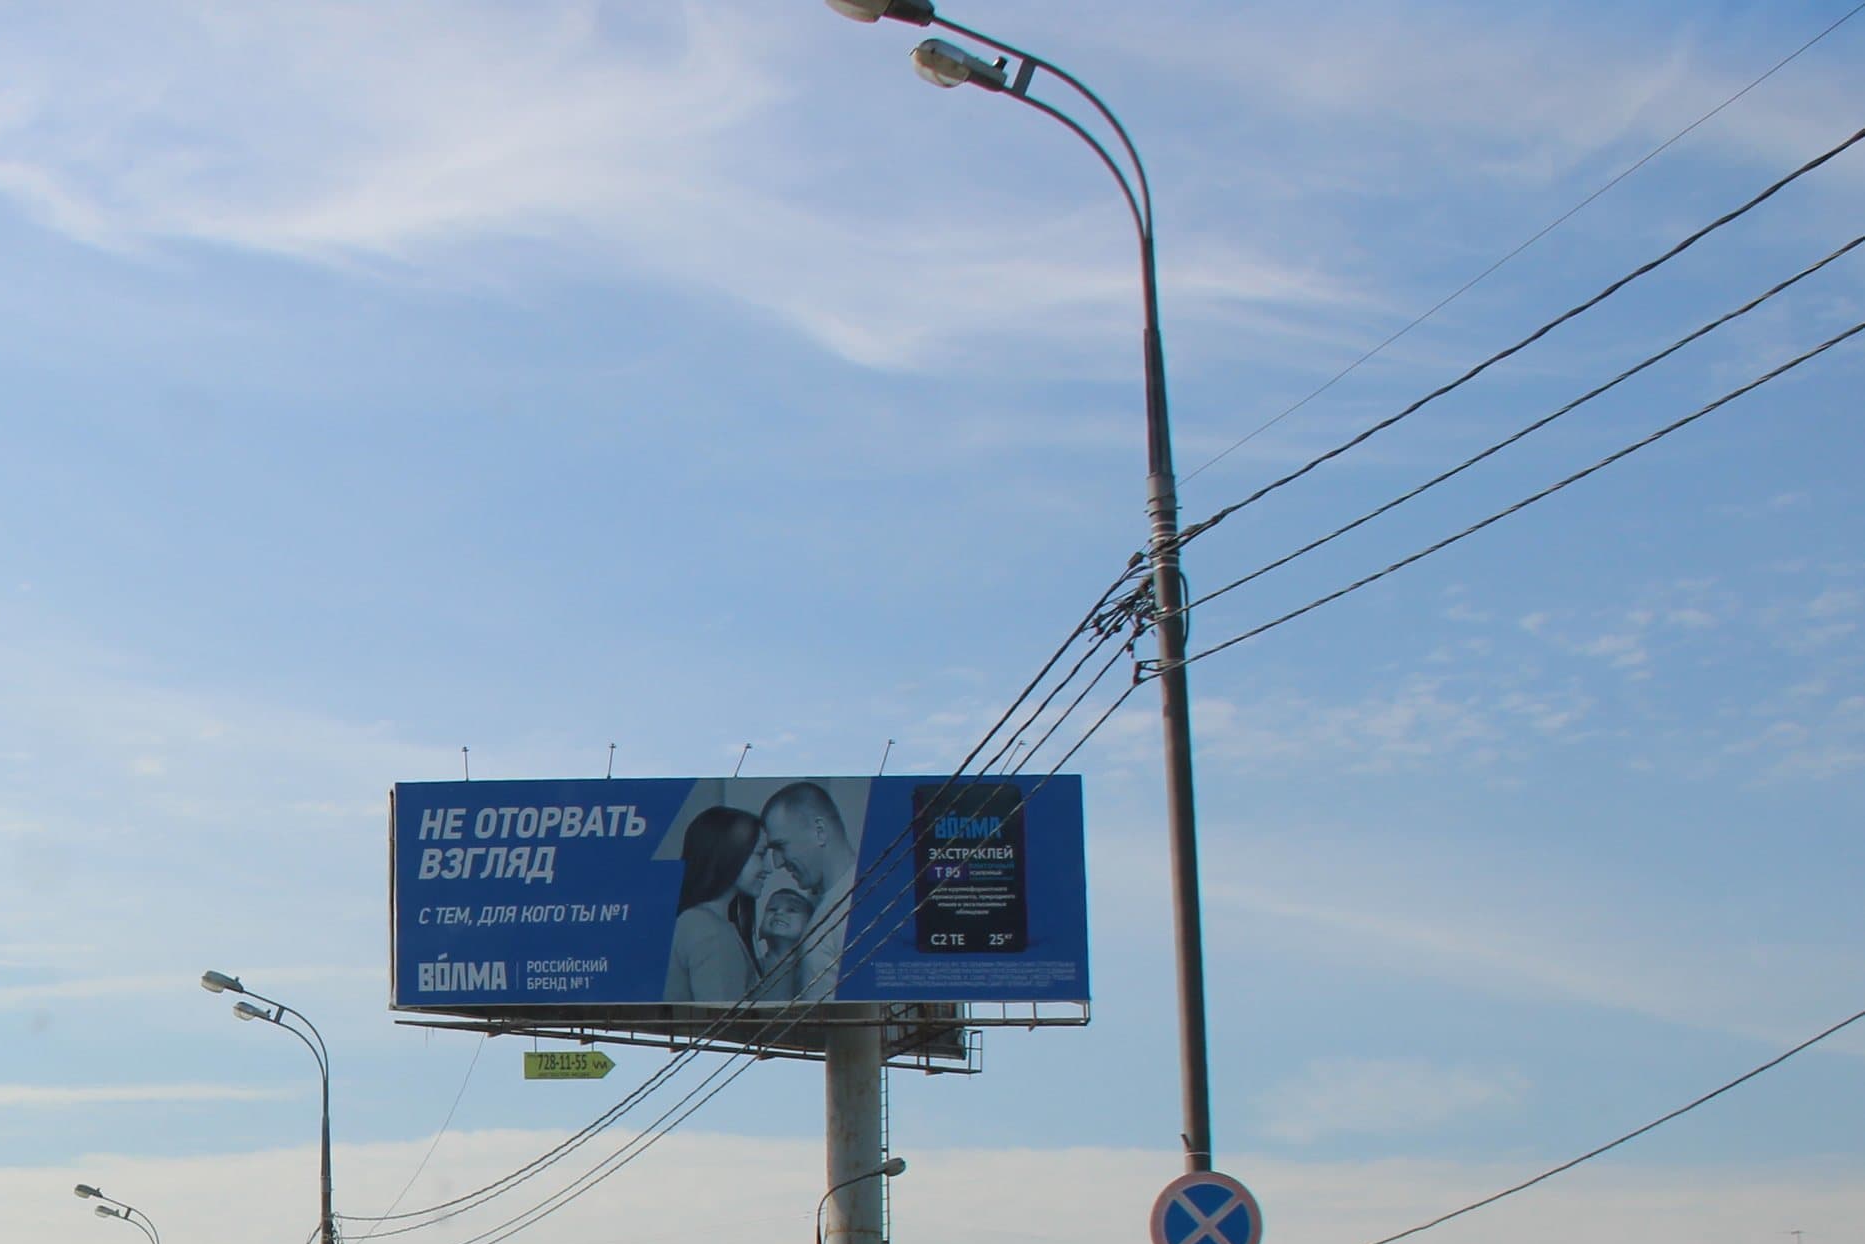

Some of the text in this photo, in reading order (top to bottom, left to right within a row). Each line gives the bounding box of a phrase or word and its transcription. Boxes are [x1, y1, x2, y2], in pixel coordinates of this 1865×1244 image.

[418, 805, 647, 840] НЕ ОТОРВАТЬ
[418, 846, 556, 884] ВЗГЛЯД
[418, 907, 431, 925] С
[436, 906, 473, 926] ТЕМ,
[477, 905, 517, 927] ДЛЯ
[570, 904, 596, 922] ТЫ
[599, 903, 629, 922] №1
[526, 957, 608, 973] РОССИЙСКИЙ
[526, 977, 567, 992] БРЕНД
[537, 1054, 587, 1070] 728-11-55
